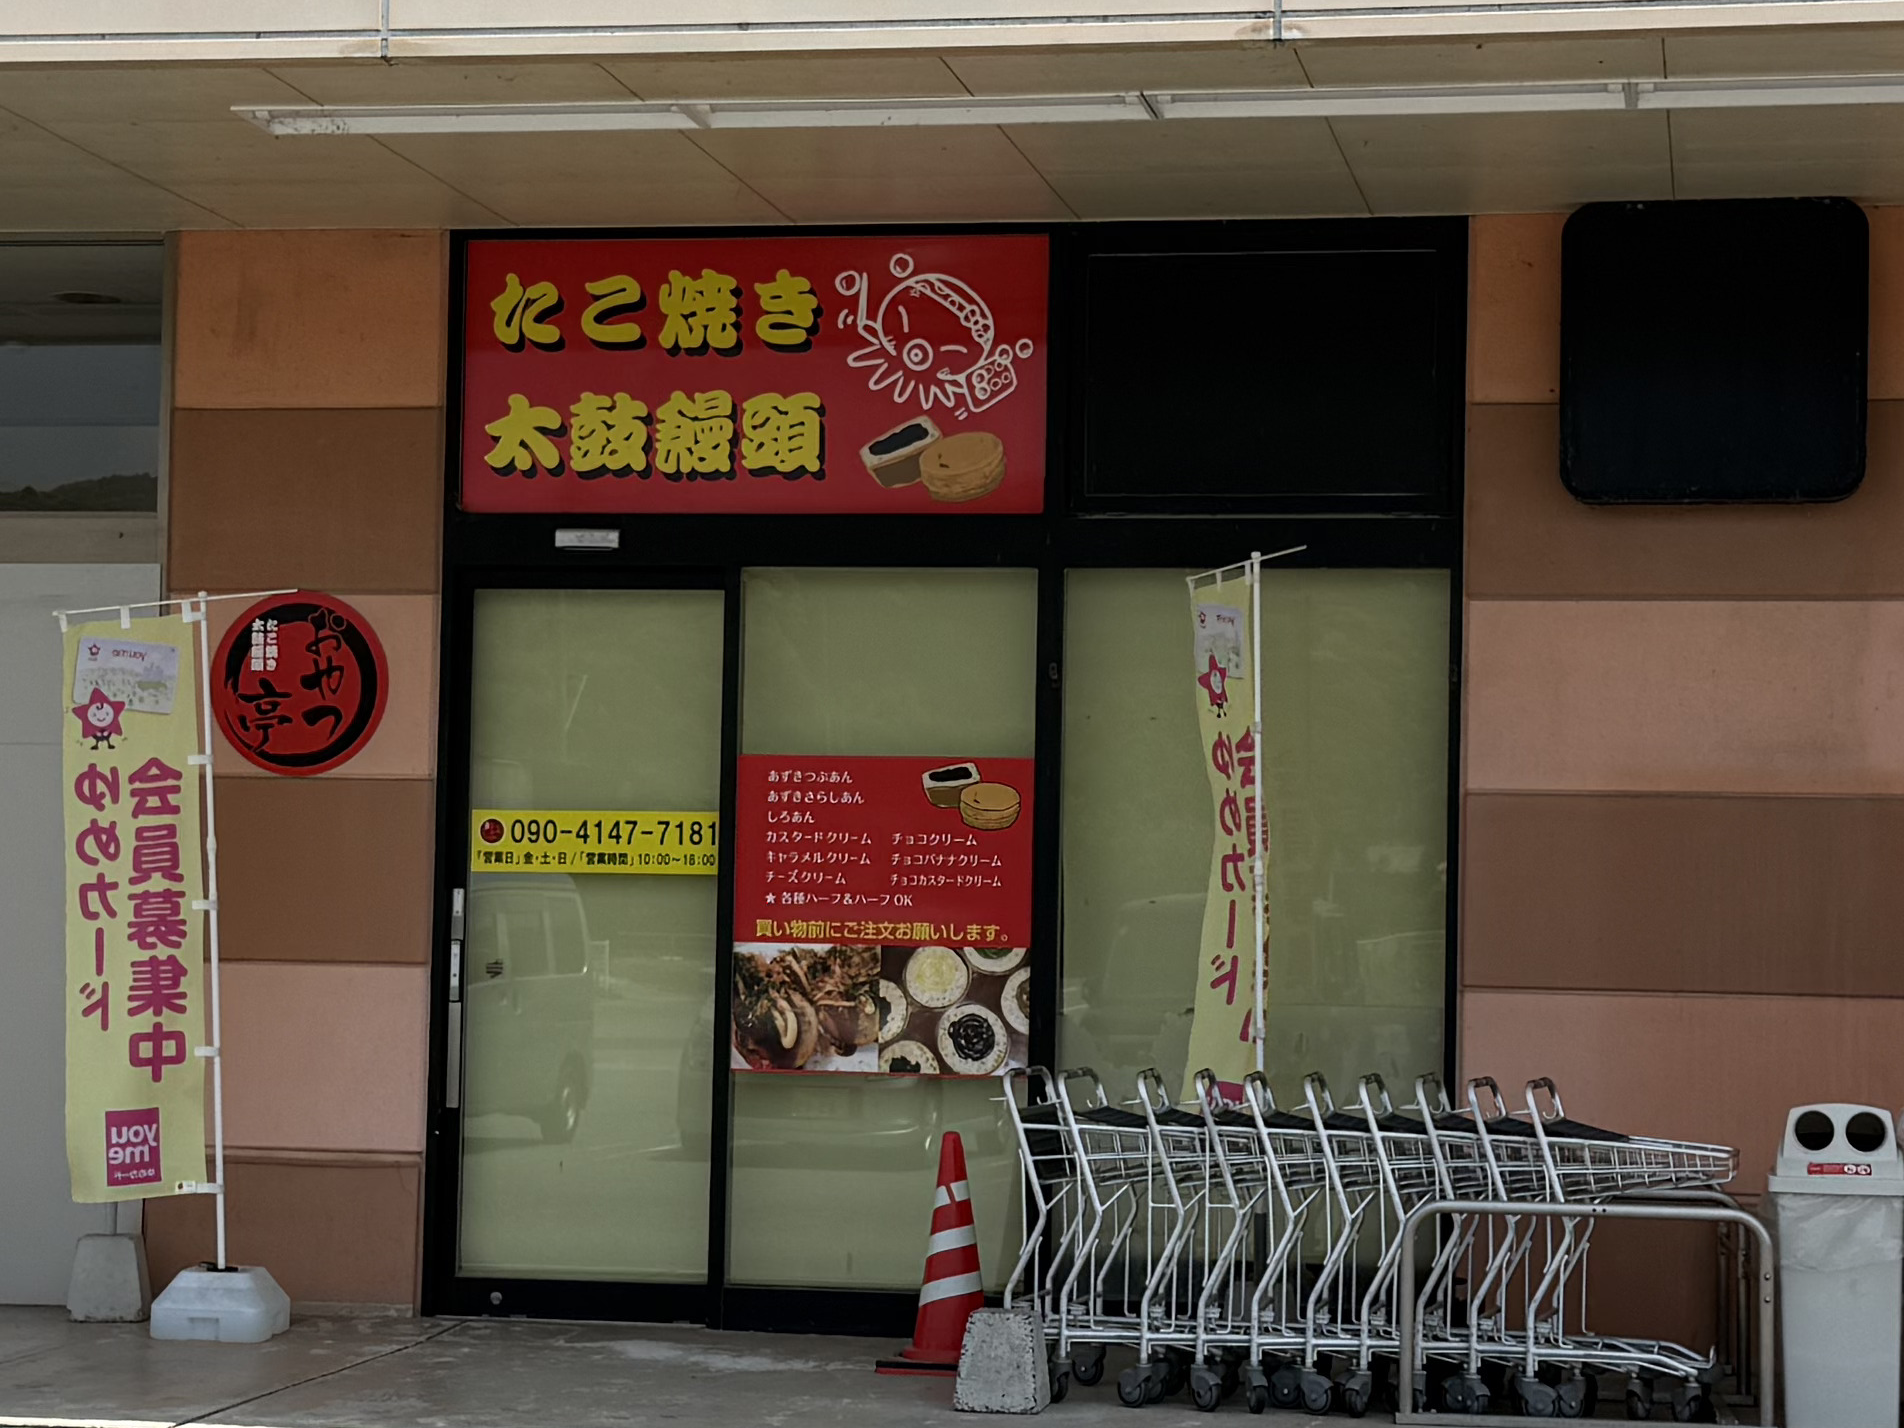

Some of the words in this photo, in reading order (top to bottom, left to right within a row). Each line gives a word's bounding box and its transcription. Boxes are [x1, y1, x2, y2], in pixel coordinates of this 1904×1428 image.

[490, 268, 823, 352] たこ焼き
[767, 810, 816, 824] しろあん
[510, 819, 718, 846] 090-4147-7181
[891, 832, 979, 847] チョコクリーム
[765, 871, 847, 885] チーズクリーム
[755, 918, 1009, 943] 買い物前にご注文お願いします。
